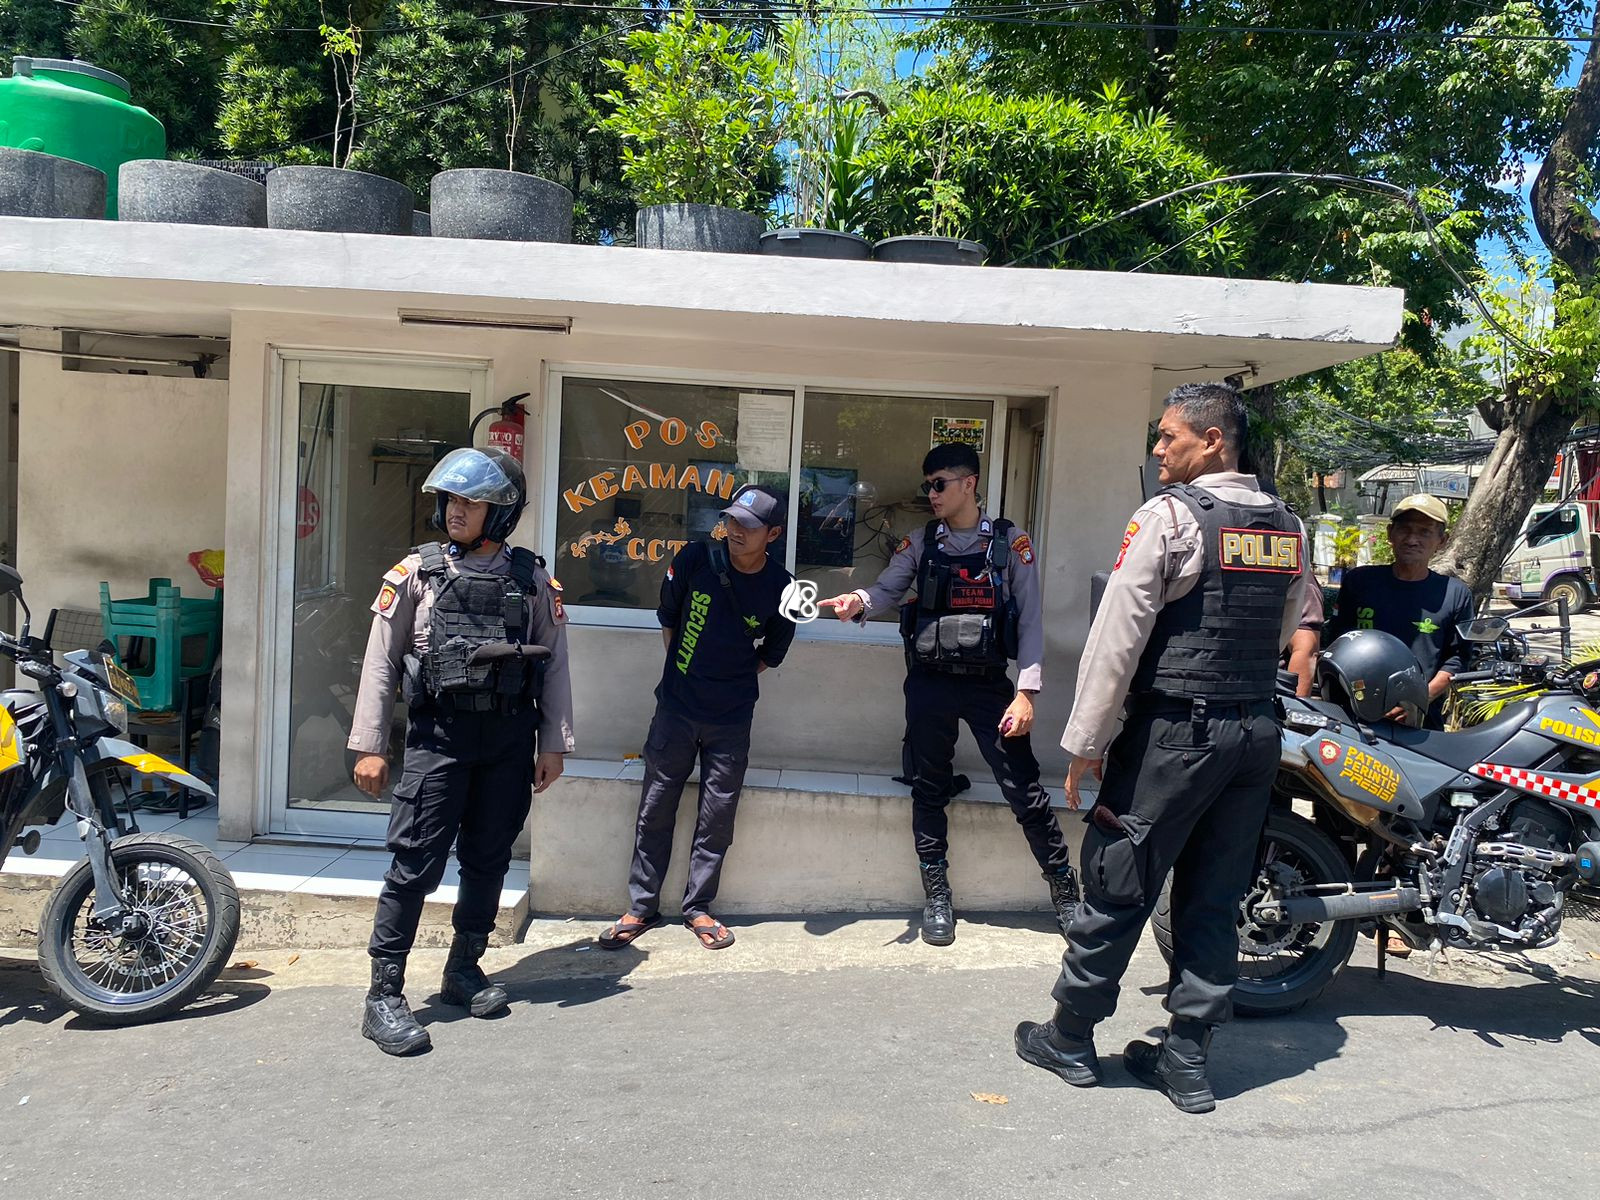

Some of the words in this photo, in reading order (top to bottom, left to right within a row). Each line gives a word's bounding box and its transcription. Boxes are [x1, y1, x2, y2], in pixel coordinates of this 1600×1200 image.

[624, 416, 724, 449] POS
[563, 463, 735, 513] KEAMAN
[627, 537, 690, 562] CCT
[1222, 532, 1298, 568] POLISI
[961, 589, 985, 597] TEAM
[676, 590, 711, 676] SECURITY
[1540, 716, 1600, 746] POLISI
[1344, 756, 1398, 793] PERINTIS
[1347, 745, 1400, 783] PATROLI
